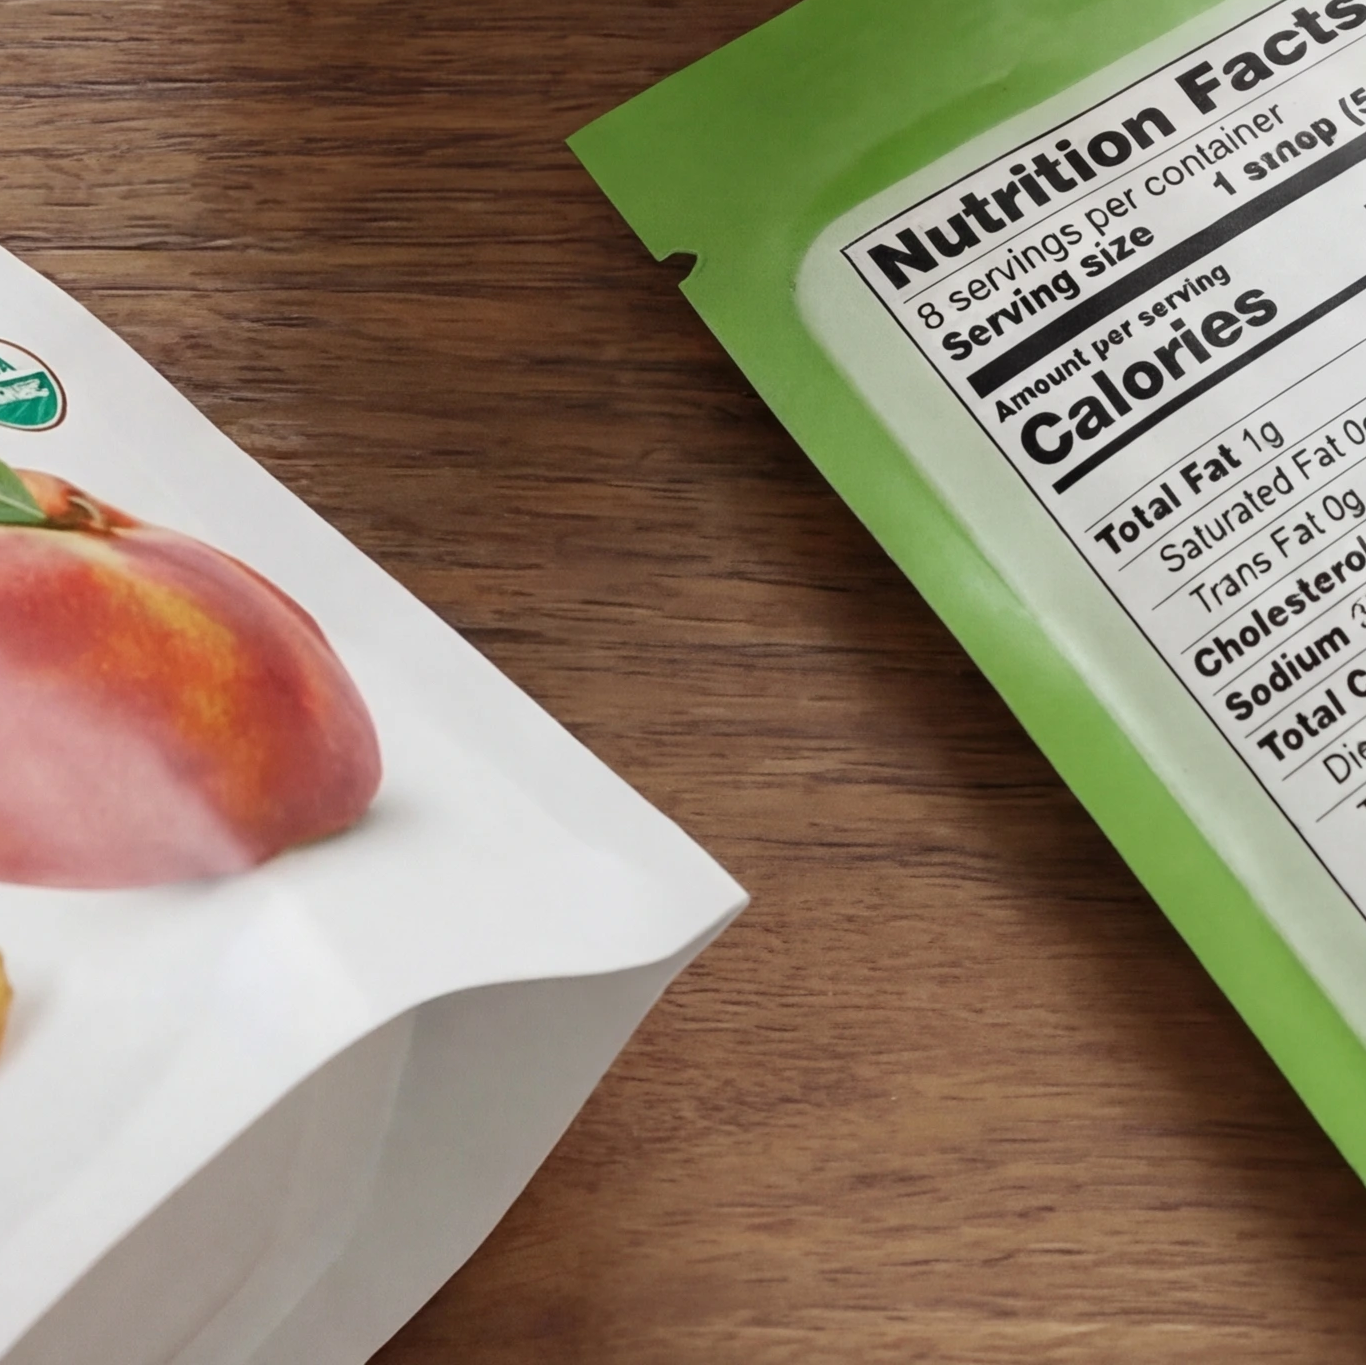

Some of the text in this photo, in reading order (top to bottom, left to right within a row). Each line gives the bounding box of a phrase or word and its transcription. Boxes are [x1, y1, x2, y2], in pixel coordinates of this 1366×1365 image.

[866, 106, 1178, 291] Nutrition
[916, 103, 1284, 330] 8 servings per container
[941, 268, 1082, 362] Serving
[1079, 225, 1155, 279] size
[994, 264, 1232, 424] Amount per serving
[1019, 288, 1279, 466] Calories
[1092, 481, 1183, 556] Total
[1178, 443, 1243, 496] Fat
[1242, 420, 1285, 453] 1g
[1159, 465, 1295, 573] Saturated
[1290, 434, 1347, 481] Fat
[1188, 510, 1327, 614] Trans Fat
[1224, 625, 1352, 722] Sodium
[1255, 687, 1347, 762] Total
